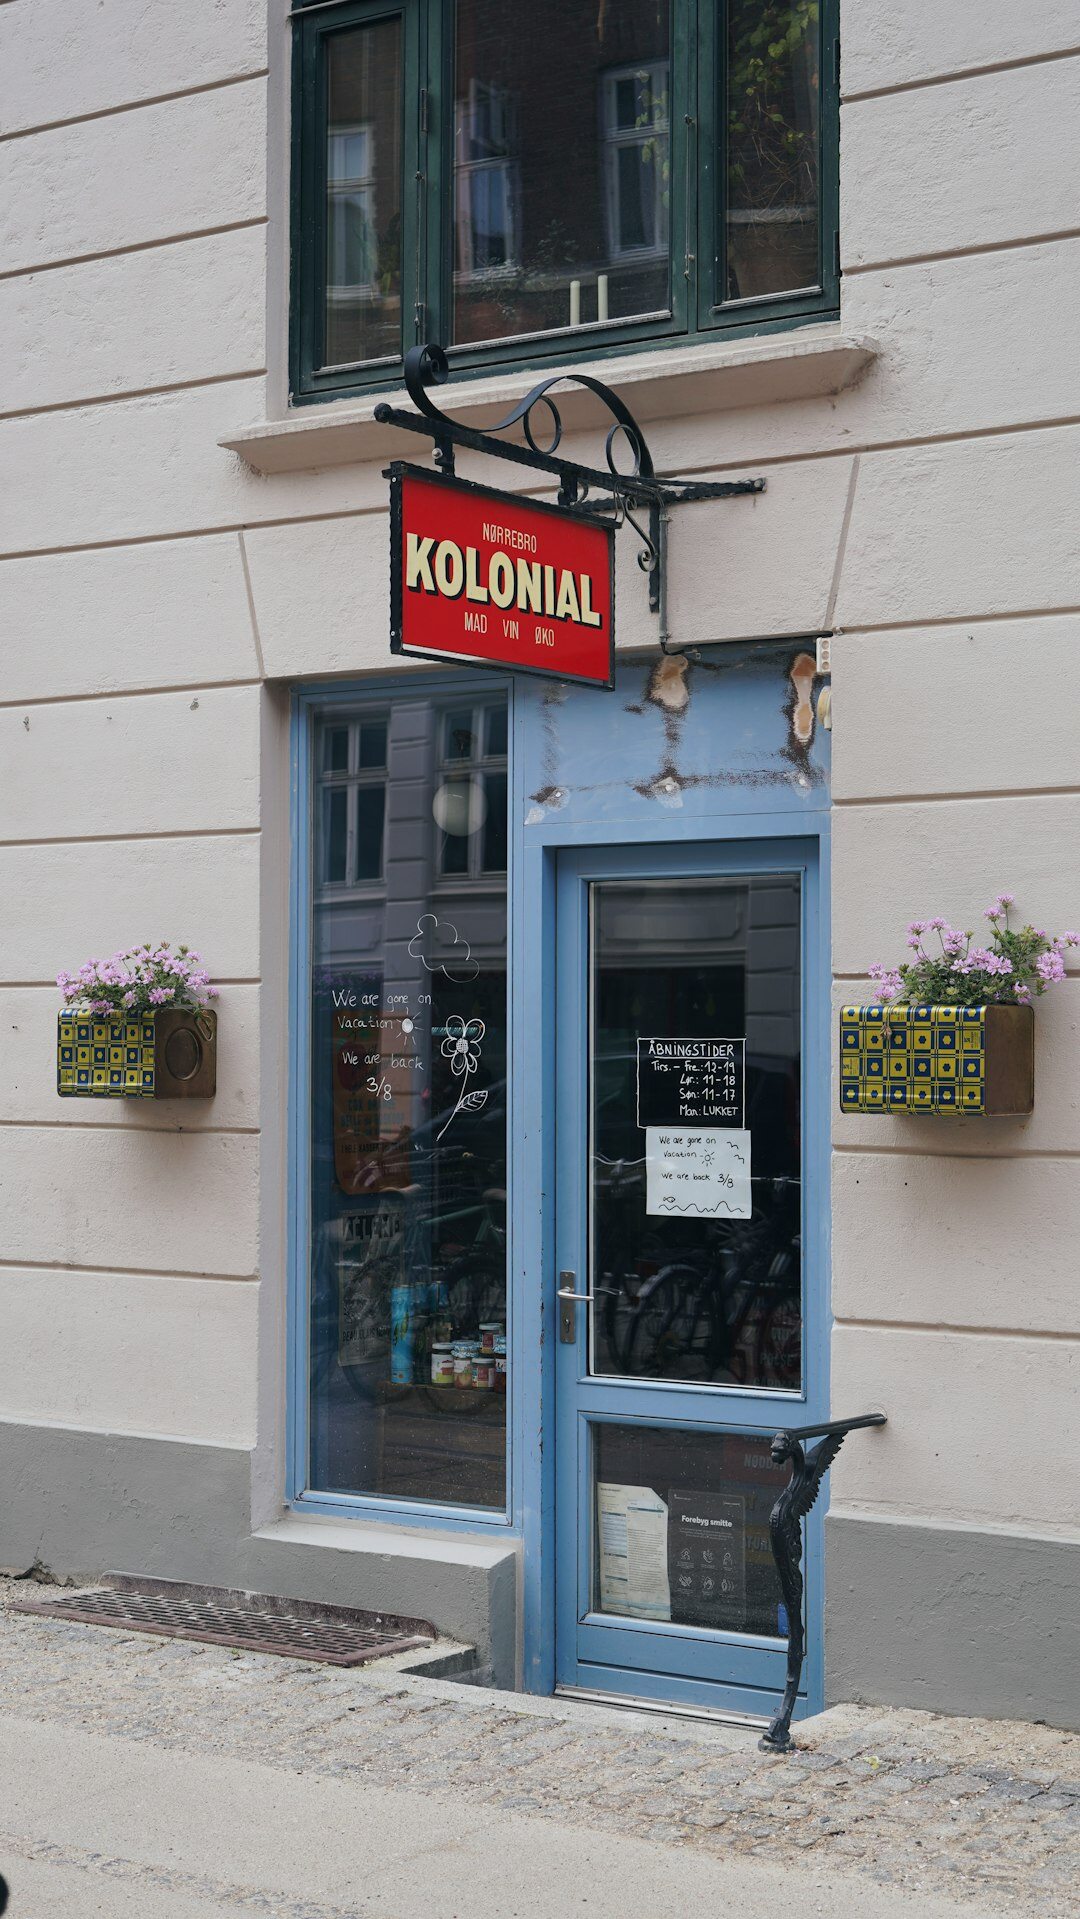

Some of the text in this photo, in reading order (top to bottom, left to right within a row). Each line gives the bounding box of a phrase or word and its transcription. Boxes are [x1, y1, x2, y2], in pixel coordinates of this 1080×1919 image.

[483, 522, 537, 553] NØRREBRO
[406, 532, 602, 629] KOLONIAL
[464, 611, 554, 646] MAD VIN ØKO
[332, 989, 432, 1012] We are gone on
[337, 1016, 393, 1029] Vacation
[342, 1052, 424, 1070] We are back
[651, 1061, 672, 1072] Tirs.
[703, 1061, 735, 1073] 12-19
[702, 1074, 736, 1085] 11-18
[366, 1076, 392, 1101] 3/8
[701, 1087, 735, 1100] 11-17
[703, 1106, 738, 1116] LUKKET
[659, 1136, 671, 1144] We
[687, 1137, 702, 1147] gone
[693, 1172, 710, 1180] back
[717, 1173, 734, 1188] 3/8
[681, 1515, 733, 1528] Forebyg smitte
